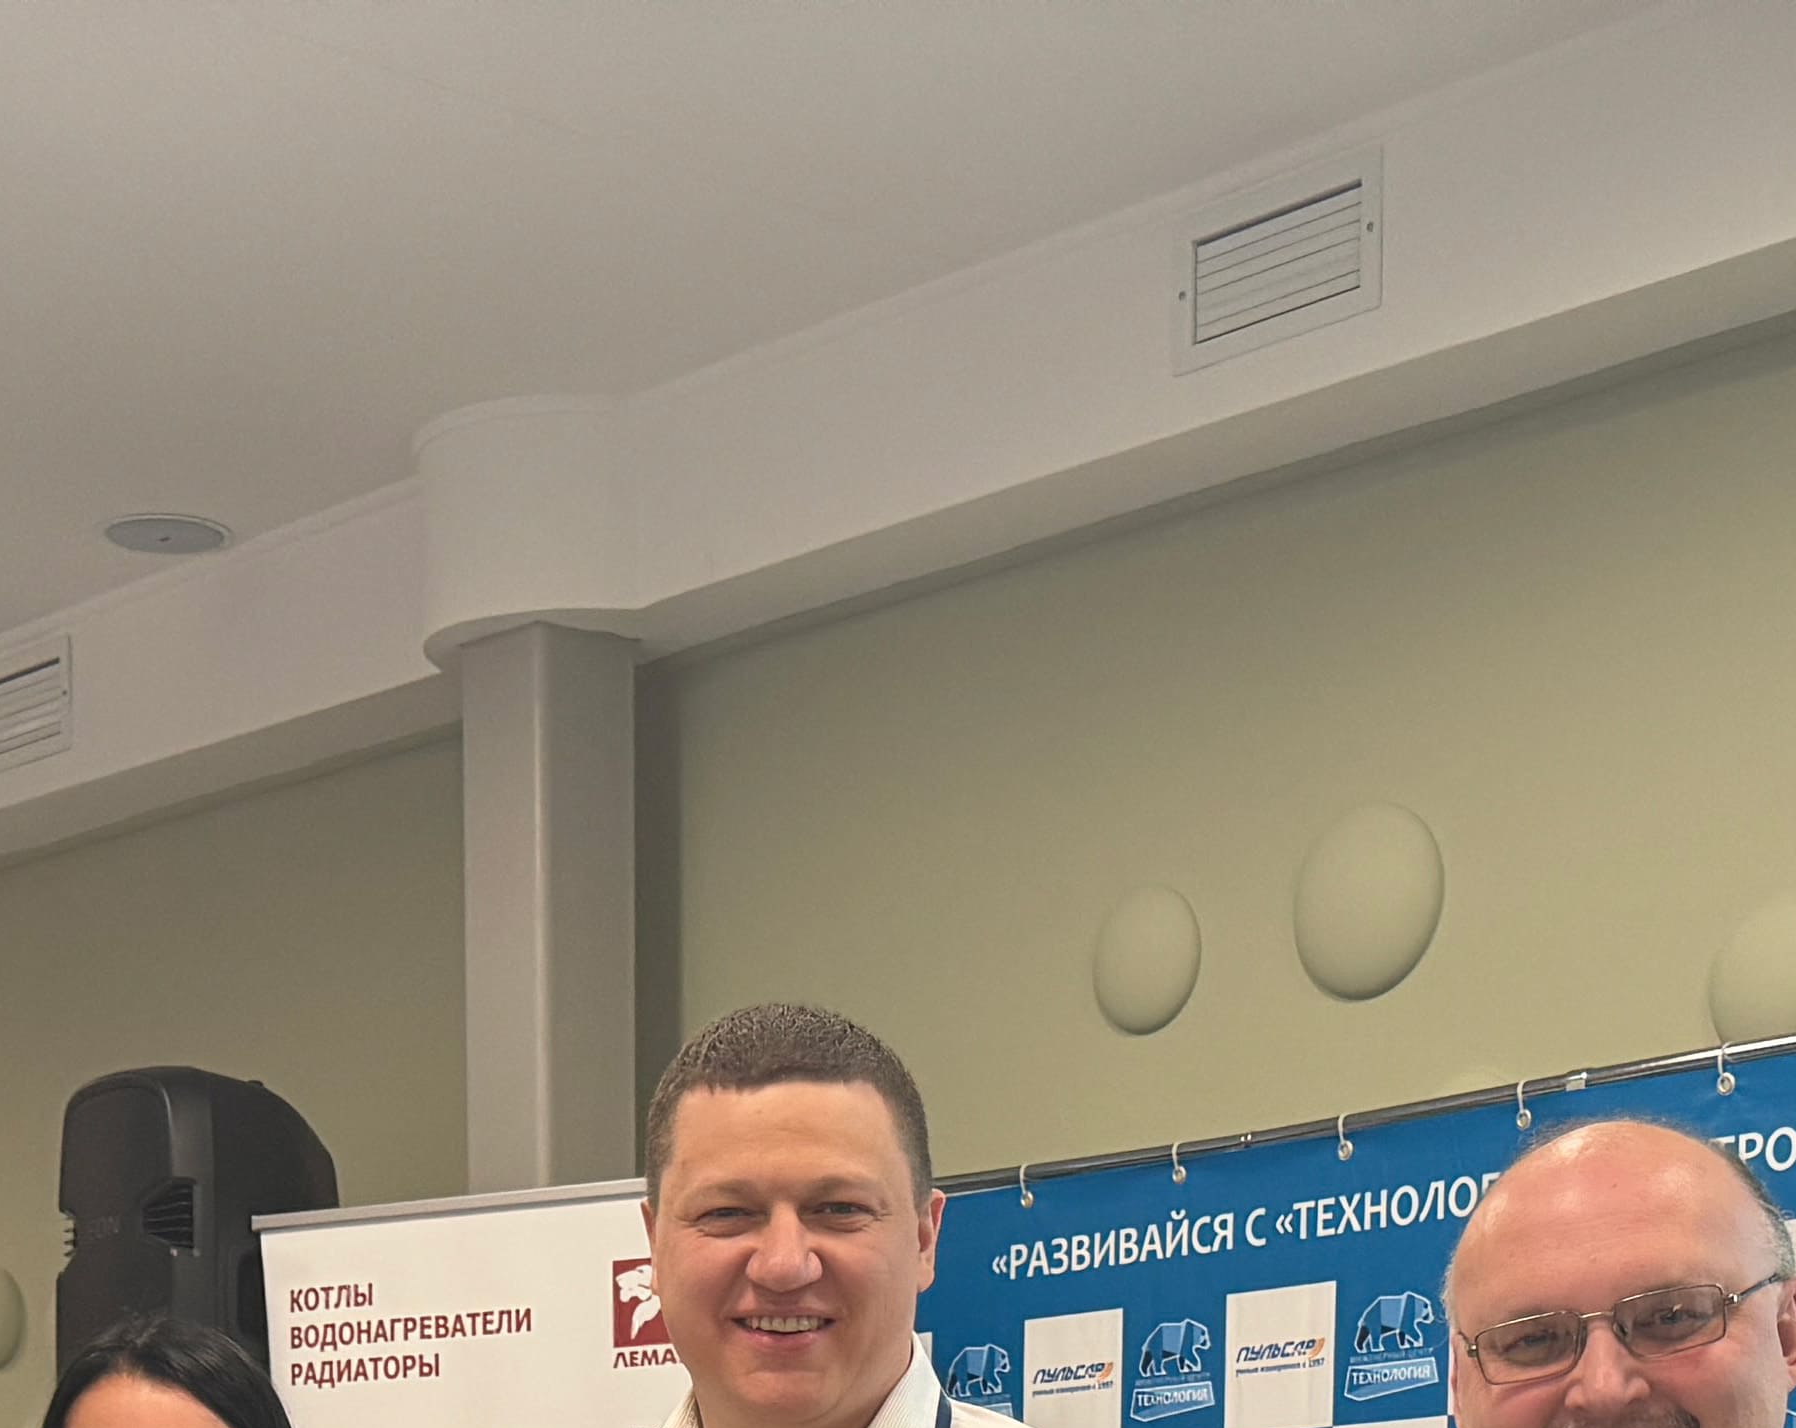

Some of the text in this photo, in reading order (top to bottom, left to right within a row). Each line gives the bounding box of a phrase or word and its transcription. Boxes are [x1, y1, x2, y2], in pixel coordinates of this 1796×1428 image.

[992, 1209, 1234, 1280] «РАЗВИВАЙСЯ
[1245, 1207, 1267, 1247] С
[1275, 1171, 1501, 1240] «ТЕХНОЛОГ
[290, 1283, 372, 1313] КОТЛЫ
[290, 1308, 531, 1352] ВОДОНАГРЕВАТЕЛИ
[613, 1348, 678, 1369] ЛЕМА
[1236, 1339, 1316, 1364] ПУЛЬСАР
[291, 1353, 439, 1389] РАДИАТОРЫ
